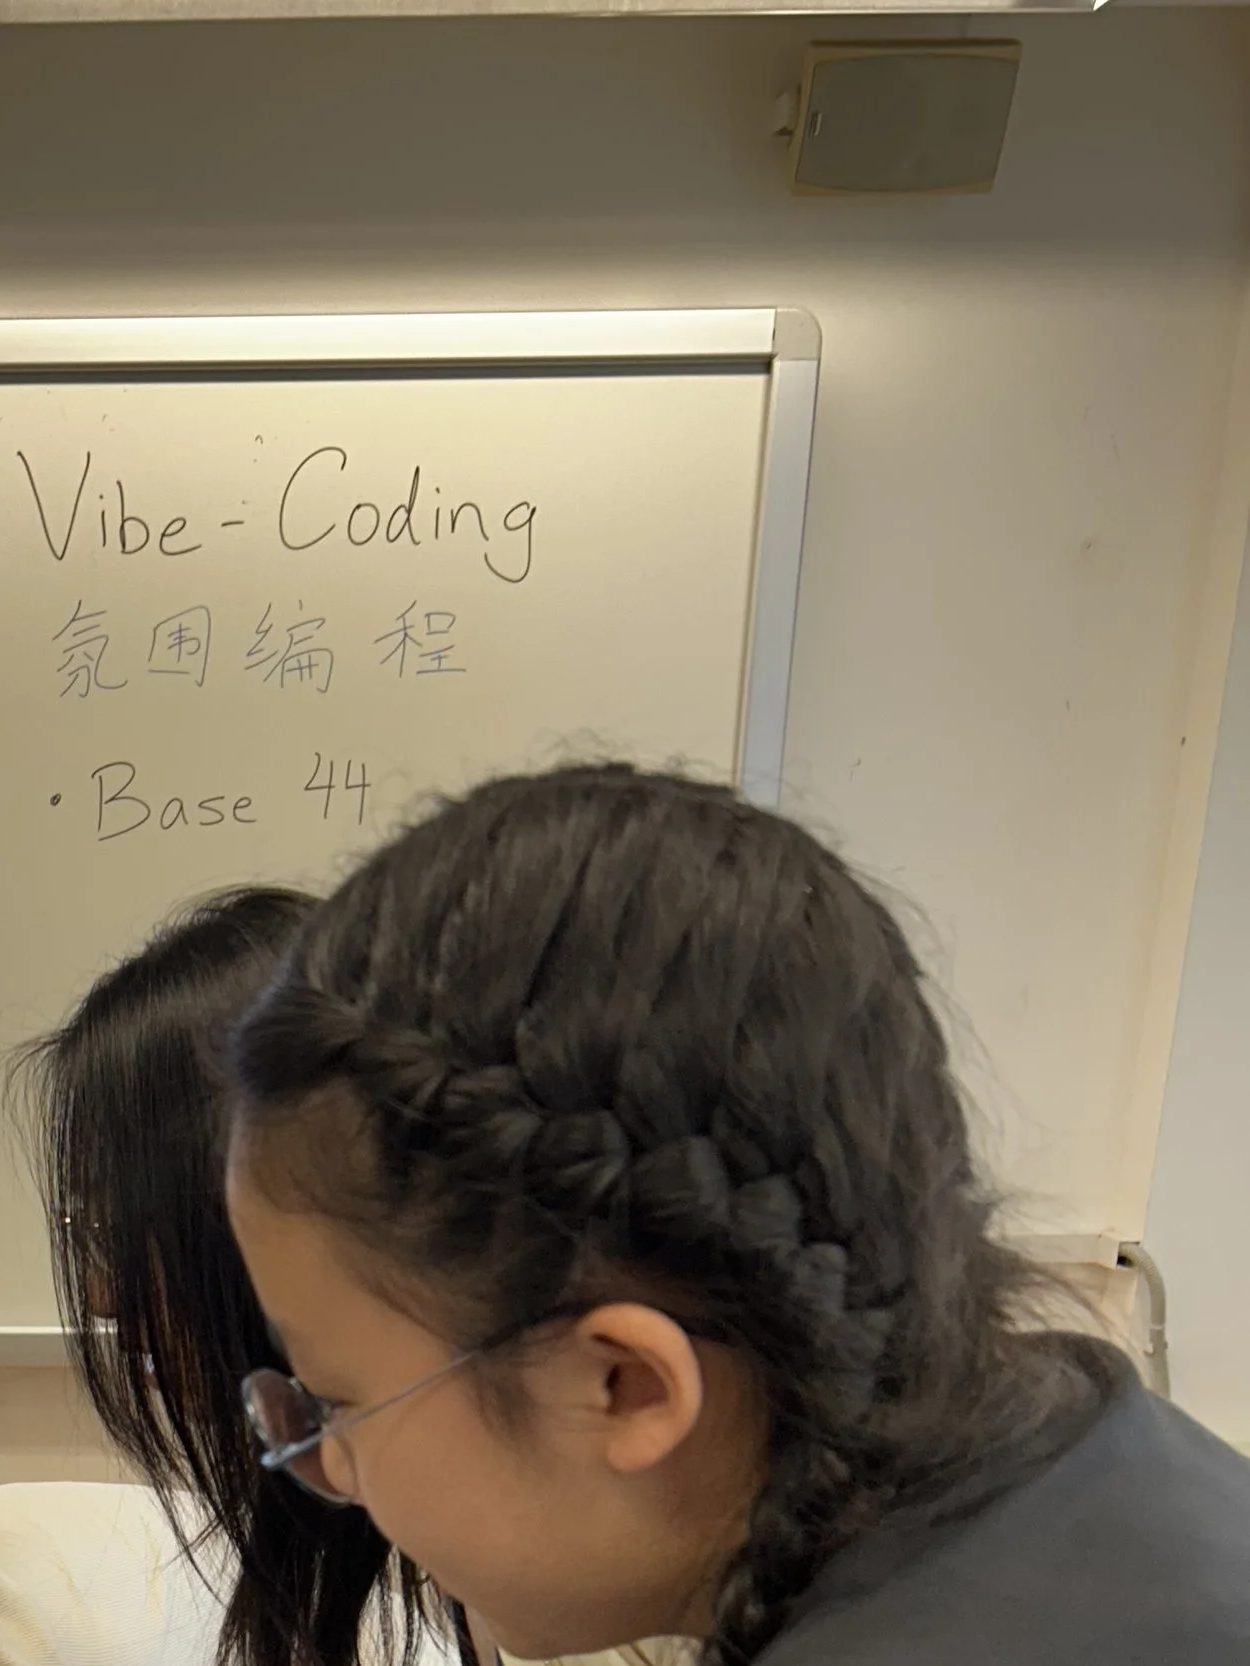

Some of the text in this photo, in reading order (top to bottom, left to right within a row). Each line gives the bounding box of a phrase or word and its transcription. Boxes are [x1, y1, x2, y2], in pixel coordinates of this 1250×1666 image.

[52, 598, 467, 698] 氛围编程
[92, 752, 372, 841] Base 44
